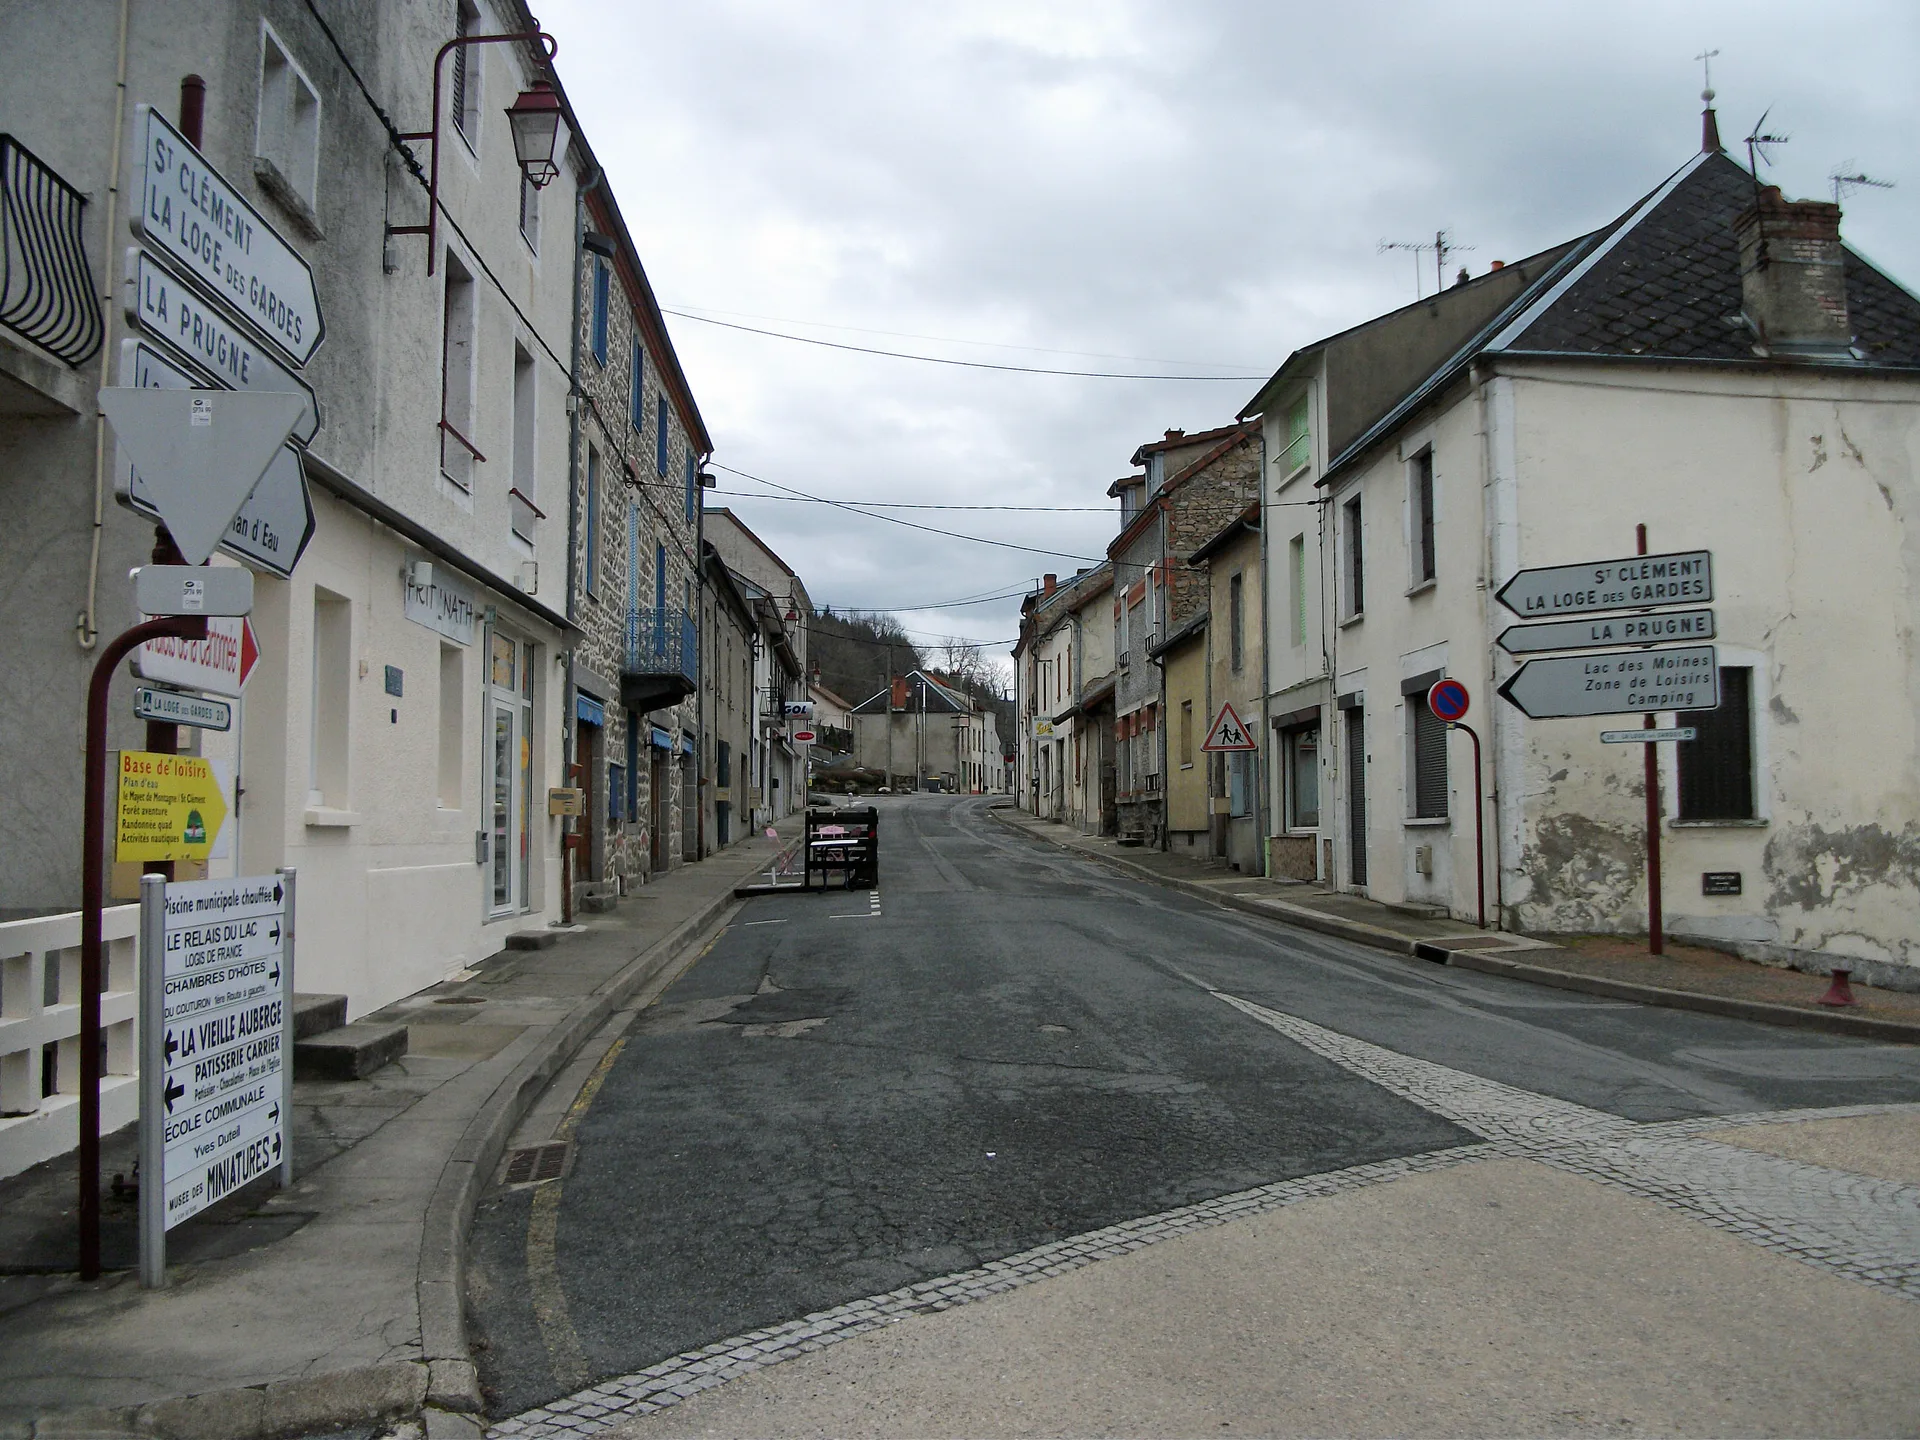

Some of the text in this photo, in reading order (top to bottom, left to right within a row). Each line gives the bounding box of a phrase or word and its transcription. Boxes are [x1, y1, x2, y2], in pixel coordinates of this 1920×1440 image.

[180, 162, 253, 256] CLÉMENT
[151, 184, 302, 345] LA LOGE DES GARDES
[146, 275, 250, 385] LA PRUGNE
[252, 518, 279, 552] d'Eau
[1618, 559, 1703, 582] CLÉMENT
[1526, 579, 1703, 611] LA LOGE DES GARDES
[1591, 617, 1705, 640] LA PRUGNE
[1585, 655, 1709, 675] Lac des Moines
[1585, 672, 1710, 691] Zone de Loisirs
[154, 698, 162, 711] LA
[164, 700, 180, 714] LOGE
[190, 703, 213, 719] GARDES
[216, 707, 225, 721] 20
[1627, 691, 1694, 706] Camping
[124, 755, 207, 779] Base de loisirs
[123, 776, 159, 789] Plan d'eau
[145, 792, 152, 801] de
[142, 806, 168, 816] aventure
[121, 818, 173, 832] Randonnée quad
[121, 832, 180, 845] Activités nautiques
[196, 889, 239, 912] municipale
[241, 887, 272, 906] chauffée
[167, 922, 258, 951] LE RELAIS DU LAC
[185, 944, 243, 968] LOGIS DE FRANCE
[165, 961, 266, 995] CHAMBRES D'HÔTES
[176, 997, 212, 1015] COUTURON
[181, 1000, 282, 1058] LA VIEILLE AUBERGE
[195, 1034, 280, 1083] PATISSERIE CARRIER
[165, 1085, 265, 1143] ÉCOLE COMMUNALE
[193, 1124, 241, 1158] Yves Duteil
[192, 1182, 204, 1199] DES
[206, 1135, 270, 1202] MINIATURES
